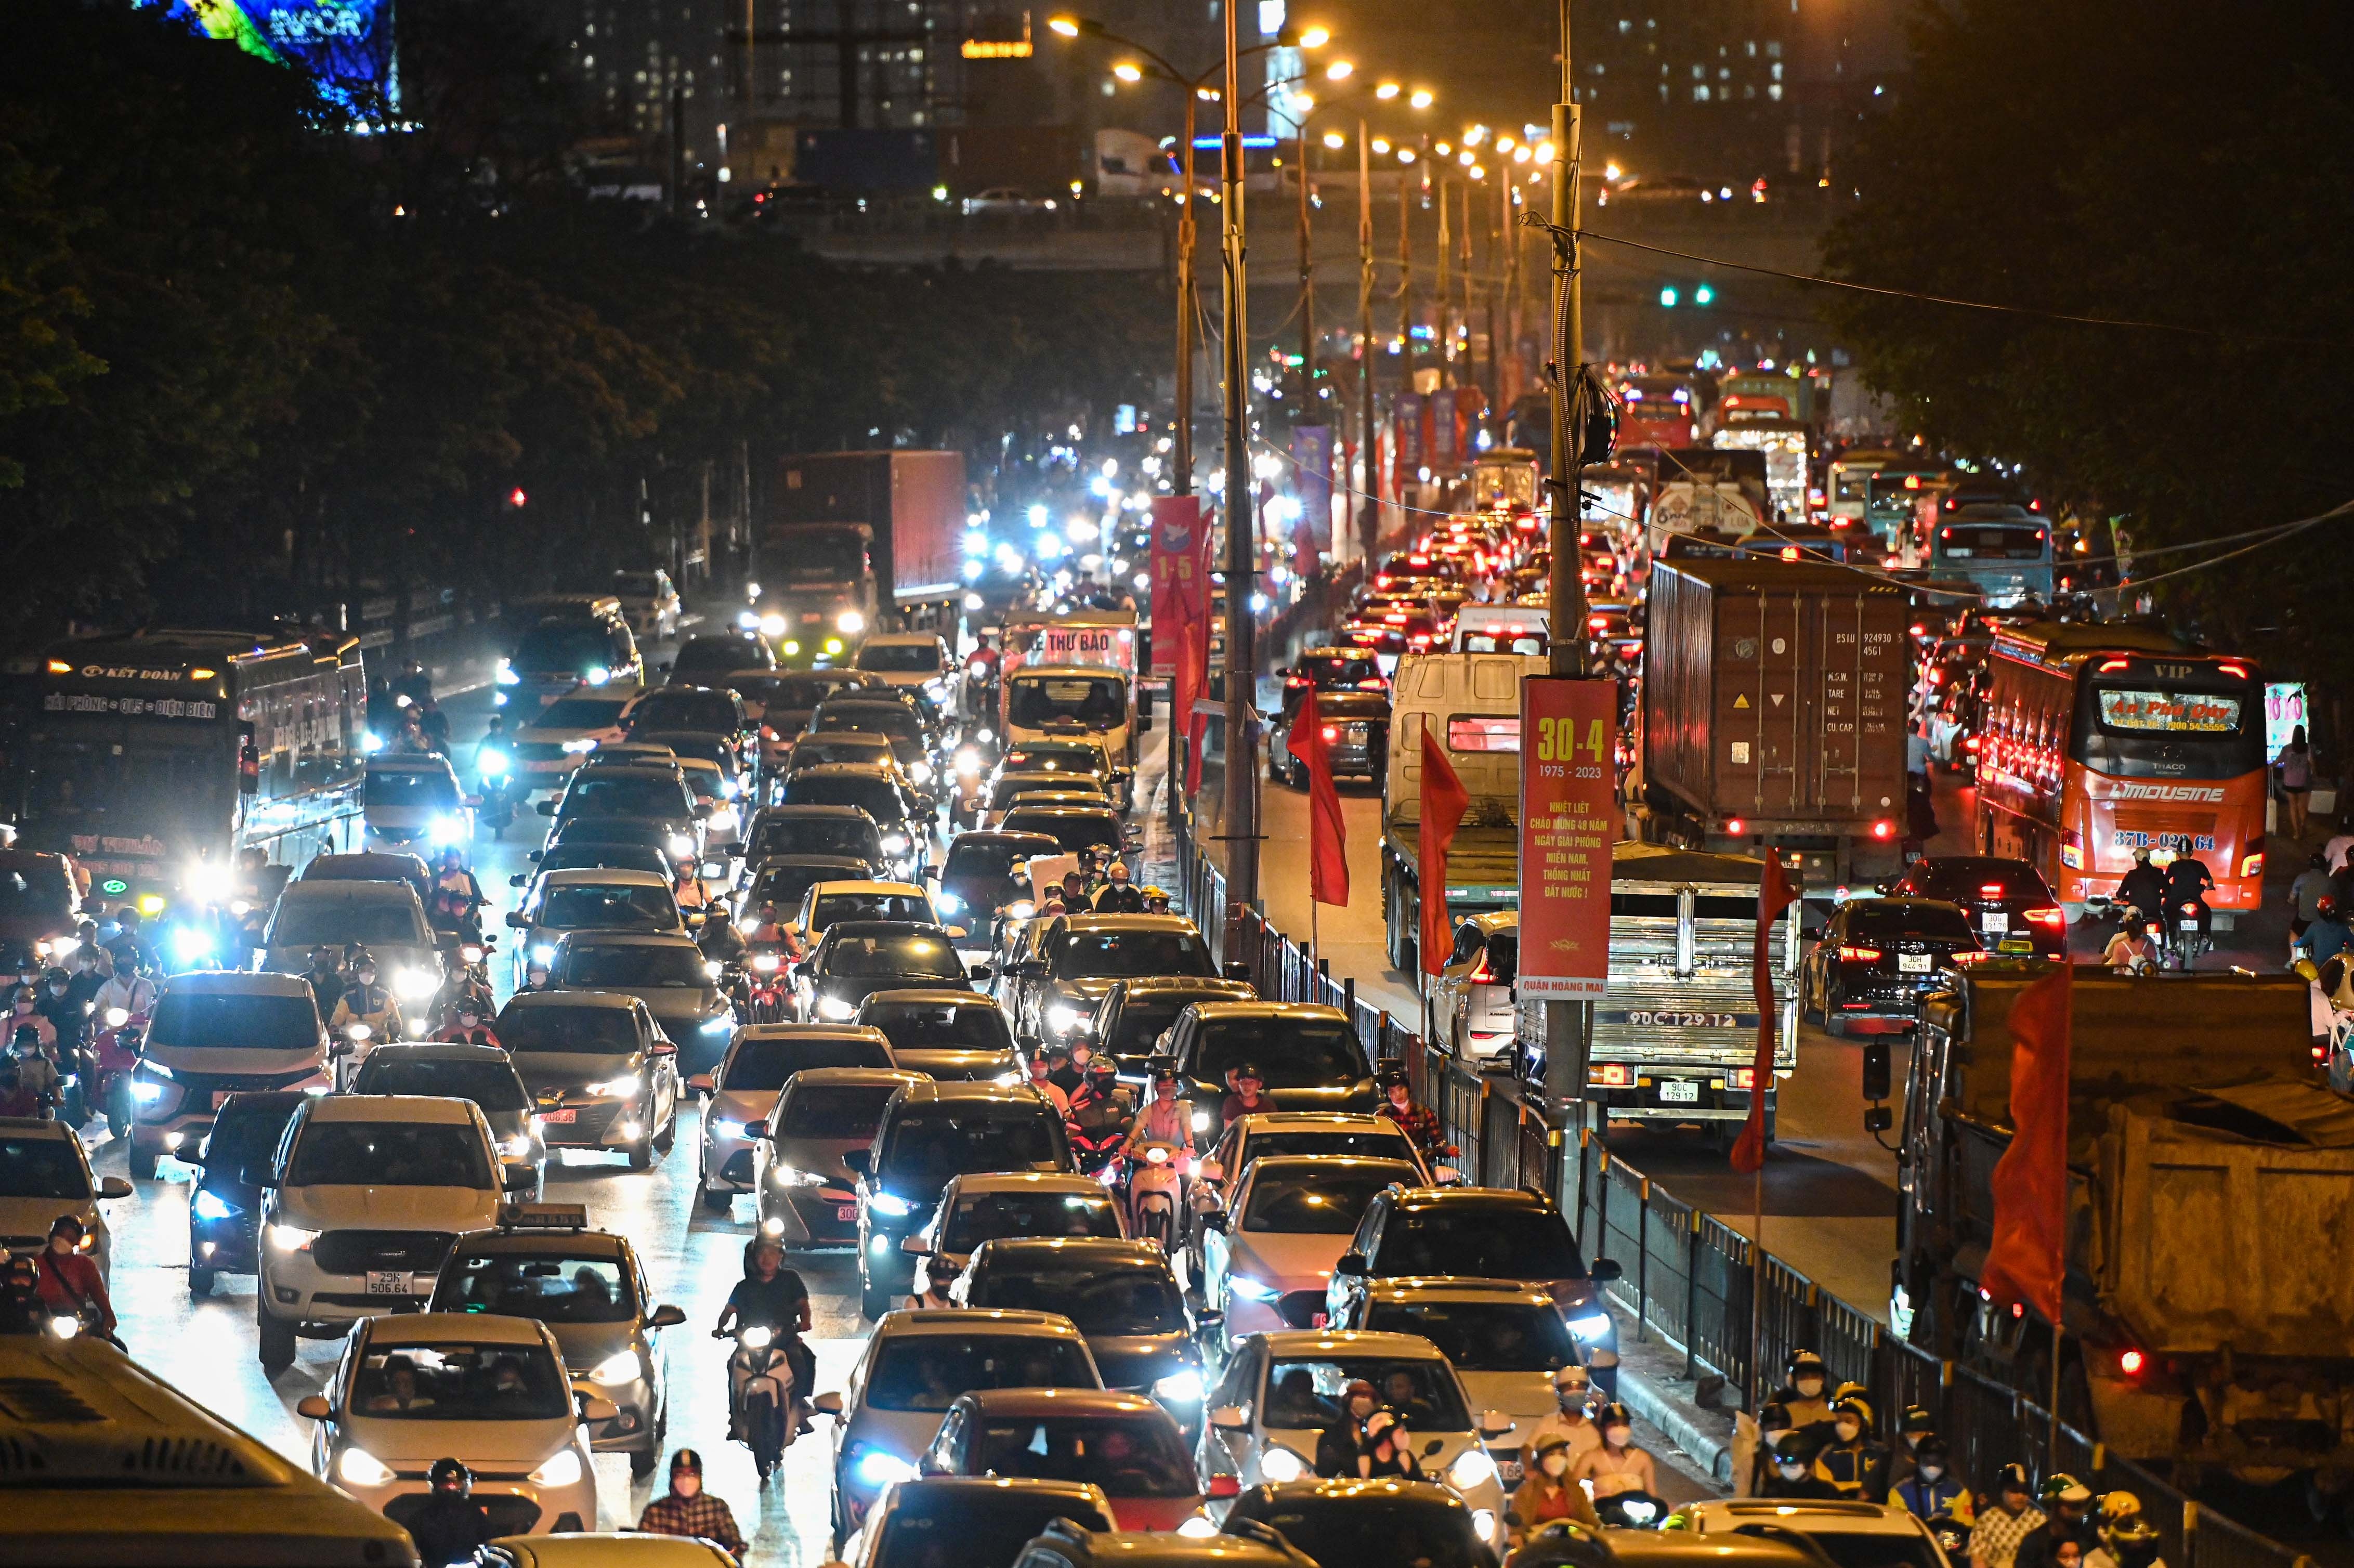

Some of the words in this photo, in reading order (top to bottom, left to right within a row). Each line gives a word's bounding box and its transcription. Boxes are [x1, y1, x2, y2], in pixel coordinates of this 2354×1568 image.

[1049, 632, 1077, 651] THƯ
[1864, 633, 1891, 643] 924930
[1863, 646, 1881, 655] 45G1
[2154, 664, 2192, 678] VIP
[1828, 689, 1844, 698] TARE
[1827, 706, 1839, 715] NET
[2110, 700, 2139, 714] An
[2146, 701, 2185, 716] Phú
[1839, 723, 1853, 732] CAP.
[1540, 765, 1564, 777] 1975
[1576, 767, 1601, 778] 2023
[2109, 783, 2225, 802] LIMOUSINE
[1550, 800, 1572, 815] NHIỆT
[1574, 801, 1589, 815] LIỆT
[1530, 816, 1550, 829] CHÀO
[1589, 817, 1607, 831] NĂM
[1535, 833, 1555, 846] NGÀY
[1557, 833, 1573, 846] GIẢI
[1575, 835, 1601, 847] PHÓNG
[1547, 850, 1566, 864] MIỀN
[1544, 866, 1568, 881] THỐNG
[1571, 867, 1591, 881] NHẤT
[1545, 883, 1560, 897] ĐẤT
[1562, 885, 1583, 898] NƯỚC
[1524, 979, 1549, 992] QUẬN
[1551, 979, 1583, 991] HOÀNG
[1586, 982, 1603, 992] MAI
[1672, 1083, 1687, 1091] 90C
[371, 1283, 407, 1293] 506.64
